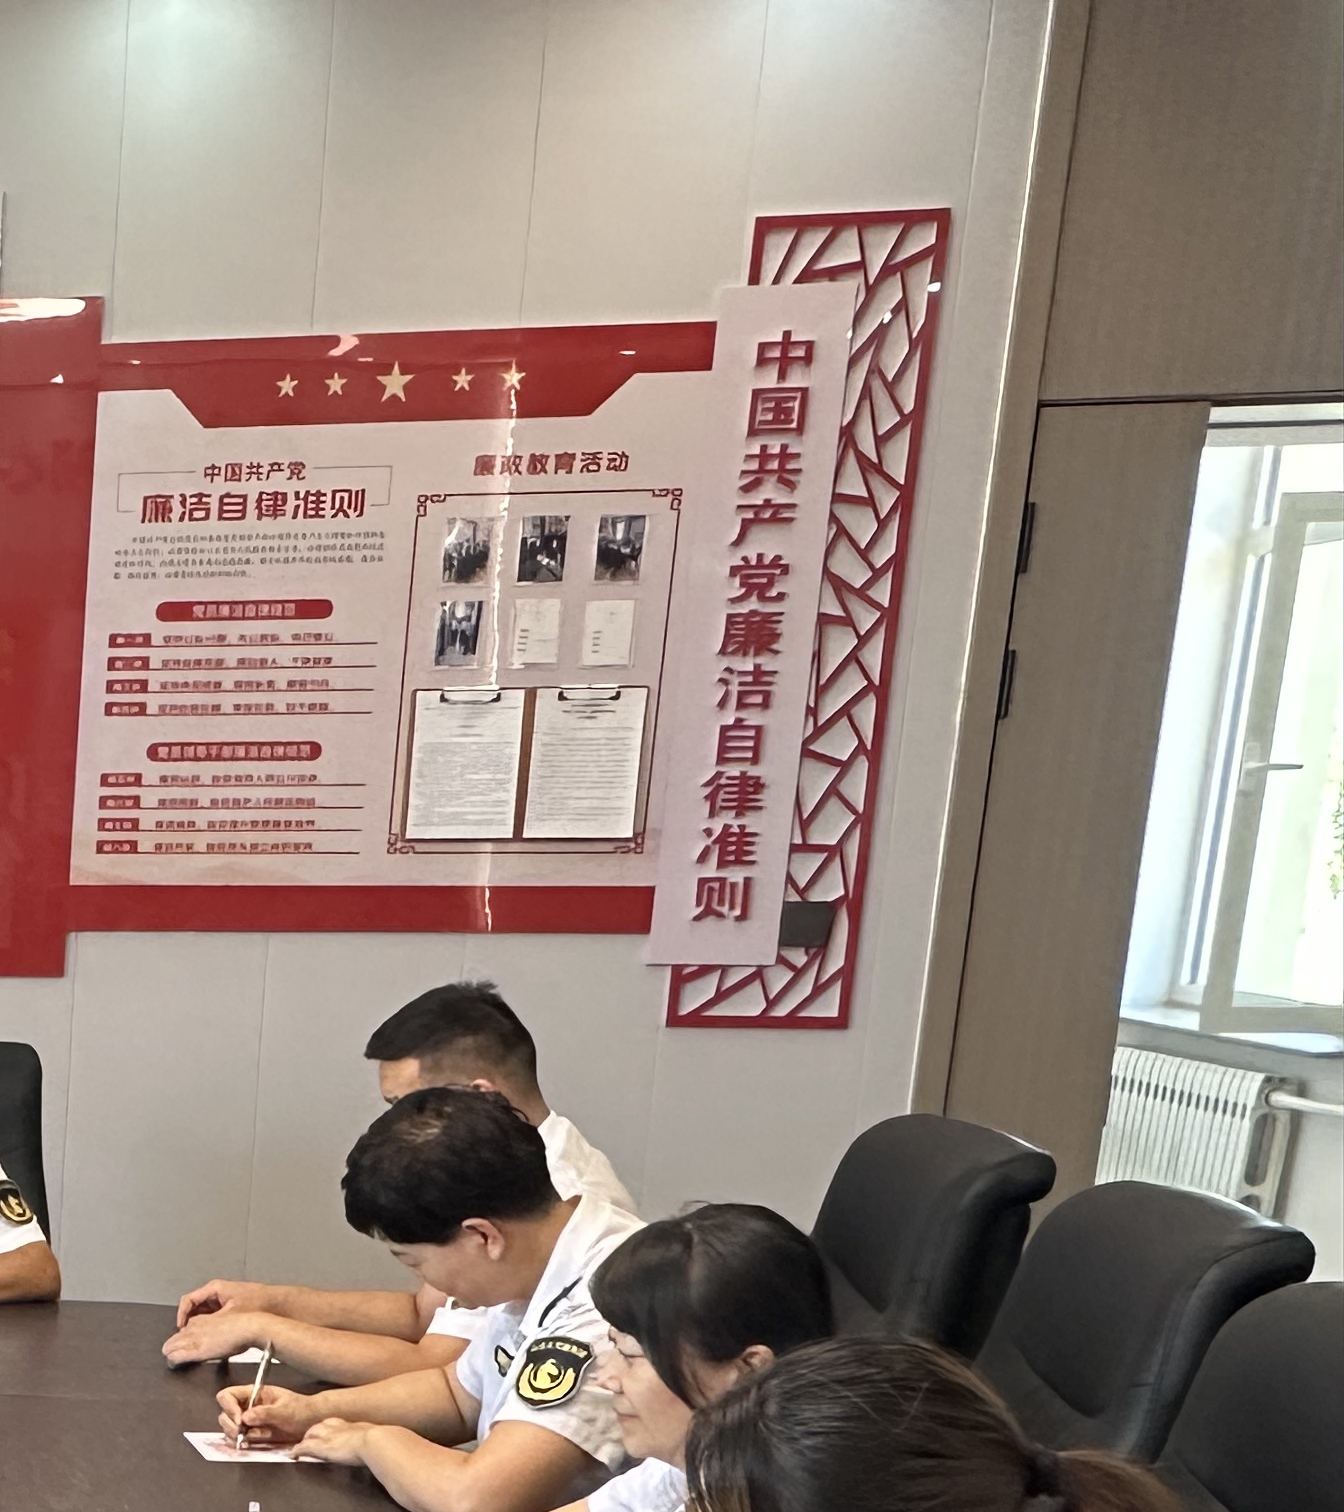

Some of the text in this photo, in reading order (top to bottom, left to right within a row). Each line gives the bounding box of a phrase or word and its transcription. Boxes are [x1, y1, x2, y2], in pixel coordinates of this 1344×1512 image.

[203, 461, 307, 484] 中国共产党
[140, 488, 367, 524] 廉洁自律准则
[690, 328, 816, 924] 中国共产党廉洁自律准则
